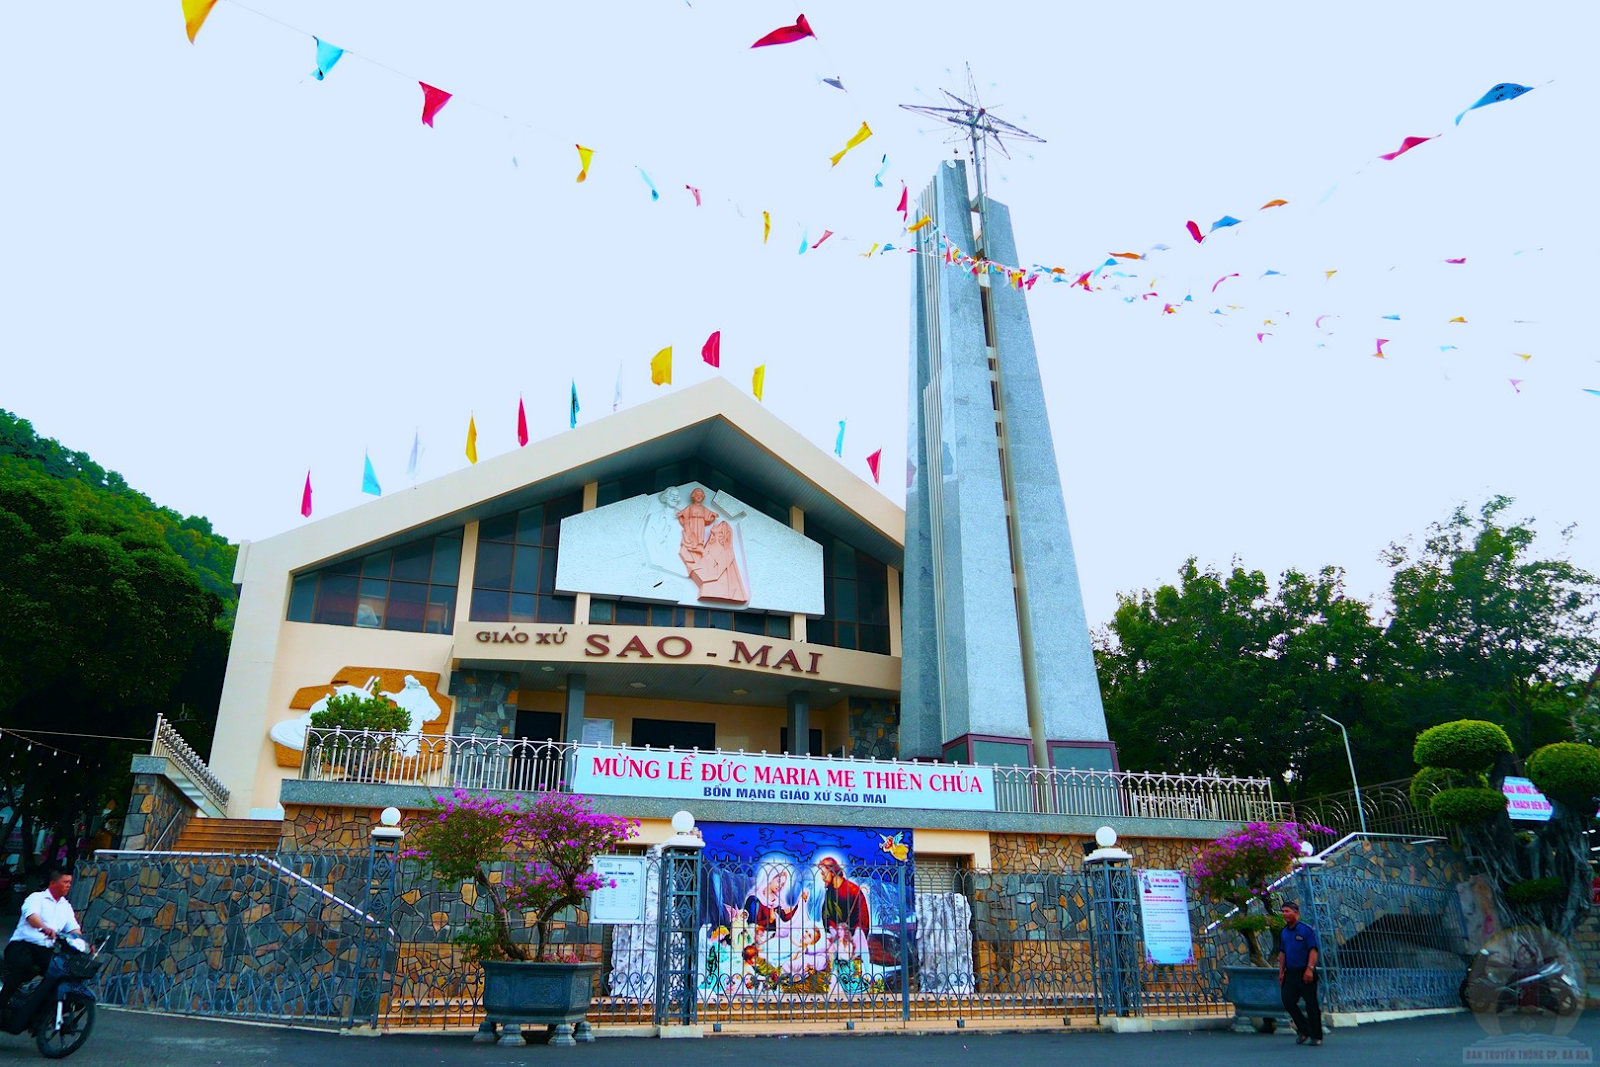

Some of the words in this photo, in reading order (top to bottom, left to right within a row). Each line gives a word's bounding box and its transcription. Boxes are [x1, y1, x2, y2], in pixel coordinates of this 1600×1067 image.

[476, 626, 529, 644] GIÁO
[536, 626, 568, 645] XỨ
[585, 633, 693, 659] SAO
[729, 640, 824, 675] MAI
[592, 753, 661, 779] MỪNG
[667, 755, 696, 780] LỄ
[701, 759, 747, 783] ĐỨC
[754, 765, 821, 786] MARIA
[827, 769, 856, 791] MẸ
[863, 768, 922, 790] THIÊN
[929, 771, 983, 793] CHÚA
[736, 788, 775, 800] MẠNG
[780, 788, 810, 801] GIÁO
[814, 789, 832, 801] XỨ
[834, 792, 859, 803] SAO
[863, 793, 887, 804] MAI
